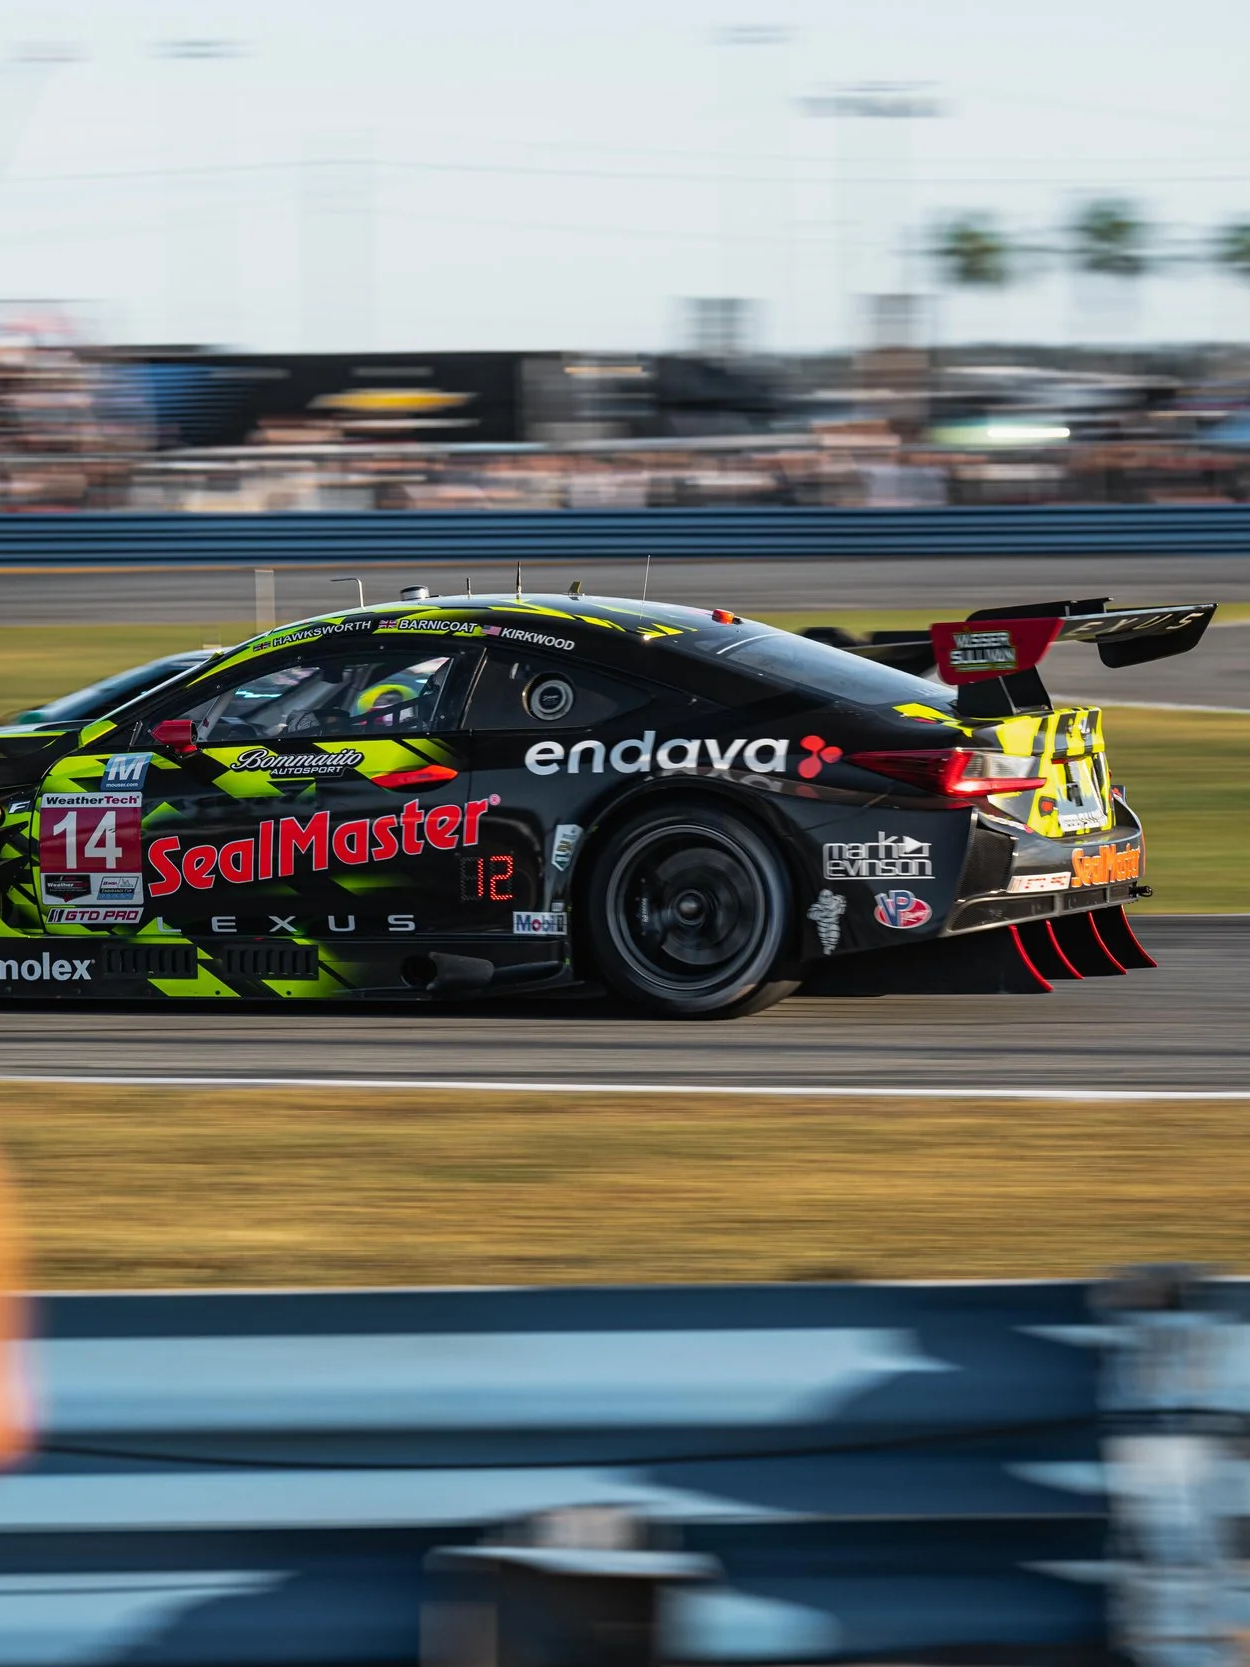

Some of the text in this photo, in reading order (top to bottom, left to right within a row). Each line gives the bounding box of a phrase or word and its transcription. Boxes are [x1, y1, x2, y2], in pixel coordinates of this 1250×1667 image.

[273, 619, 576, 651] HAWKSWORTH BARNICOAT KIRKWOOD
[1064, 612, 1205, 637] EXUS
[232, 749, 363, 769] Bommarito
[524, 730, 790, 776] endava
[270, 766, 343, 776] AUTOSPORT
[46, 796, 138, 805] WeatherTech
[53, 811, 123, 869] 14
[147, 799, 489, 897] SealMaster
[478, 855, 514, 900] 12
[64, 910, 140, 921] GTD PRO
[874, 890, 915, 927] VP
[156, 914, 417, 933] LEXUS
